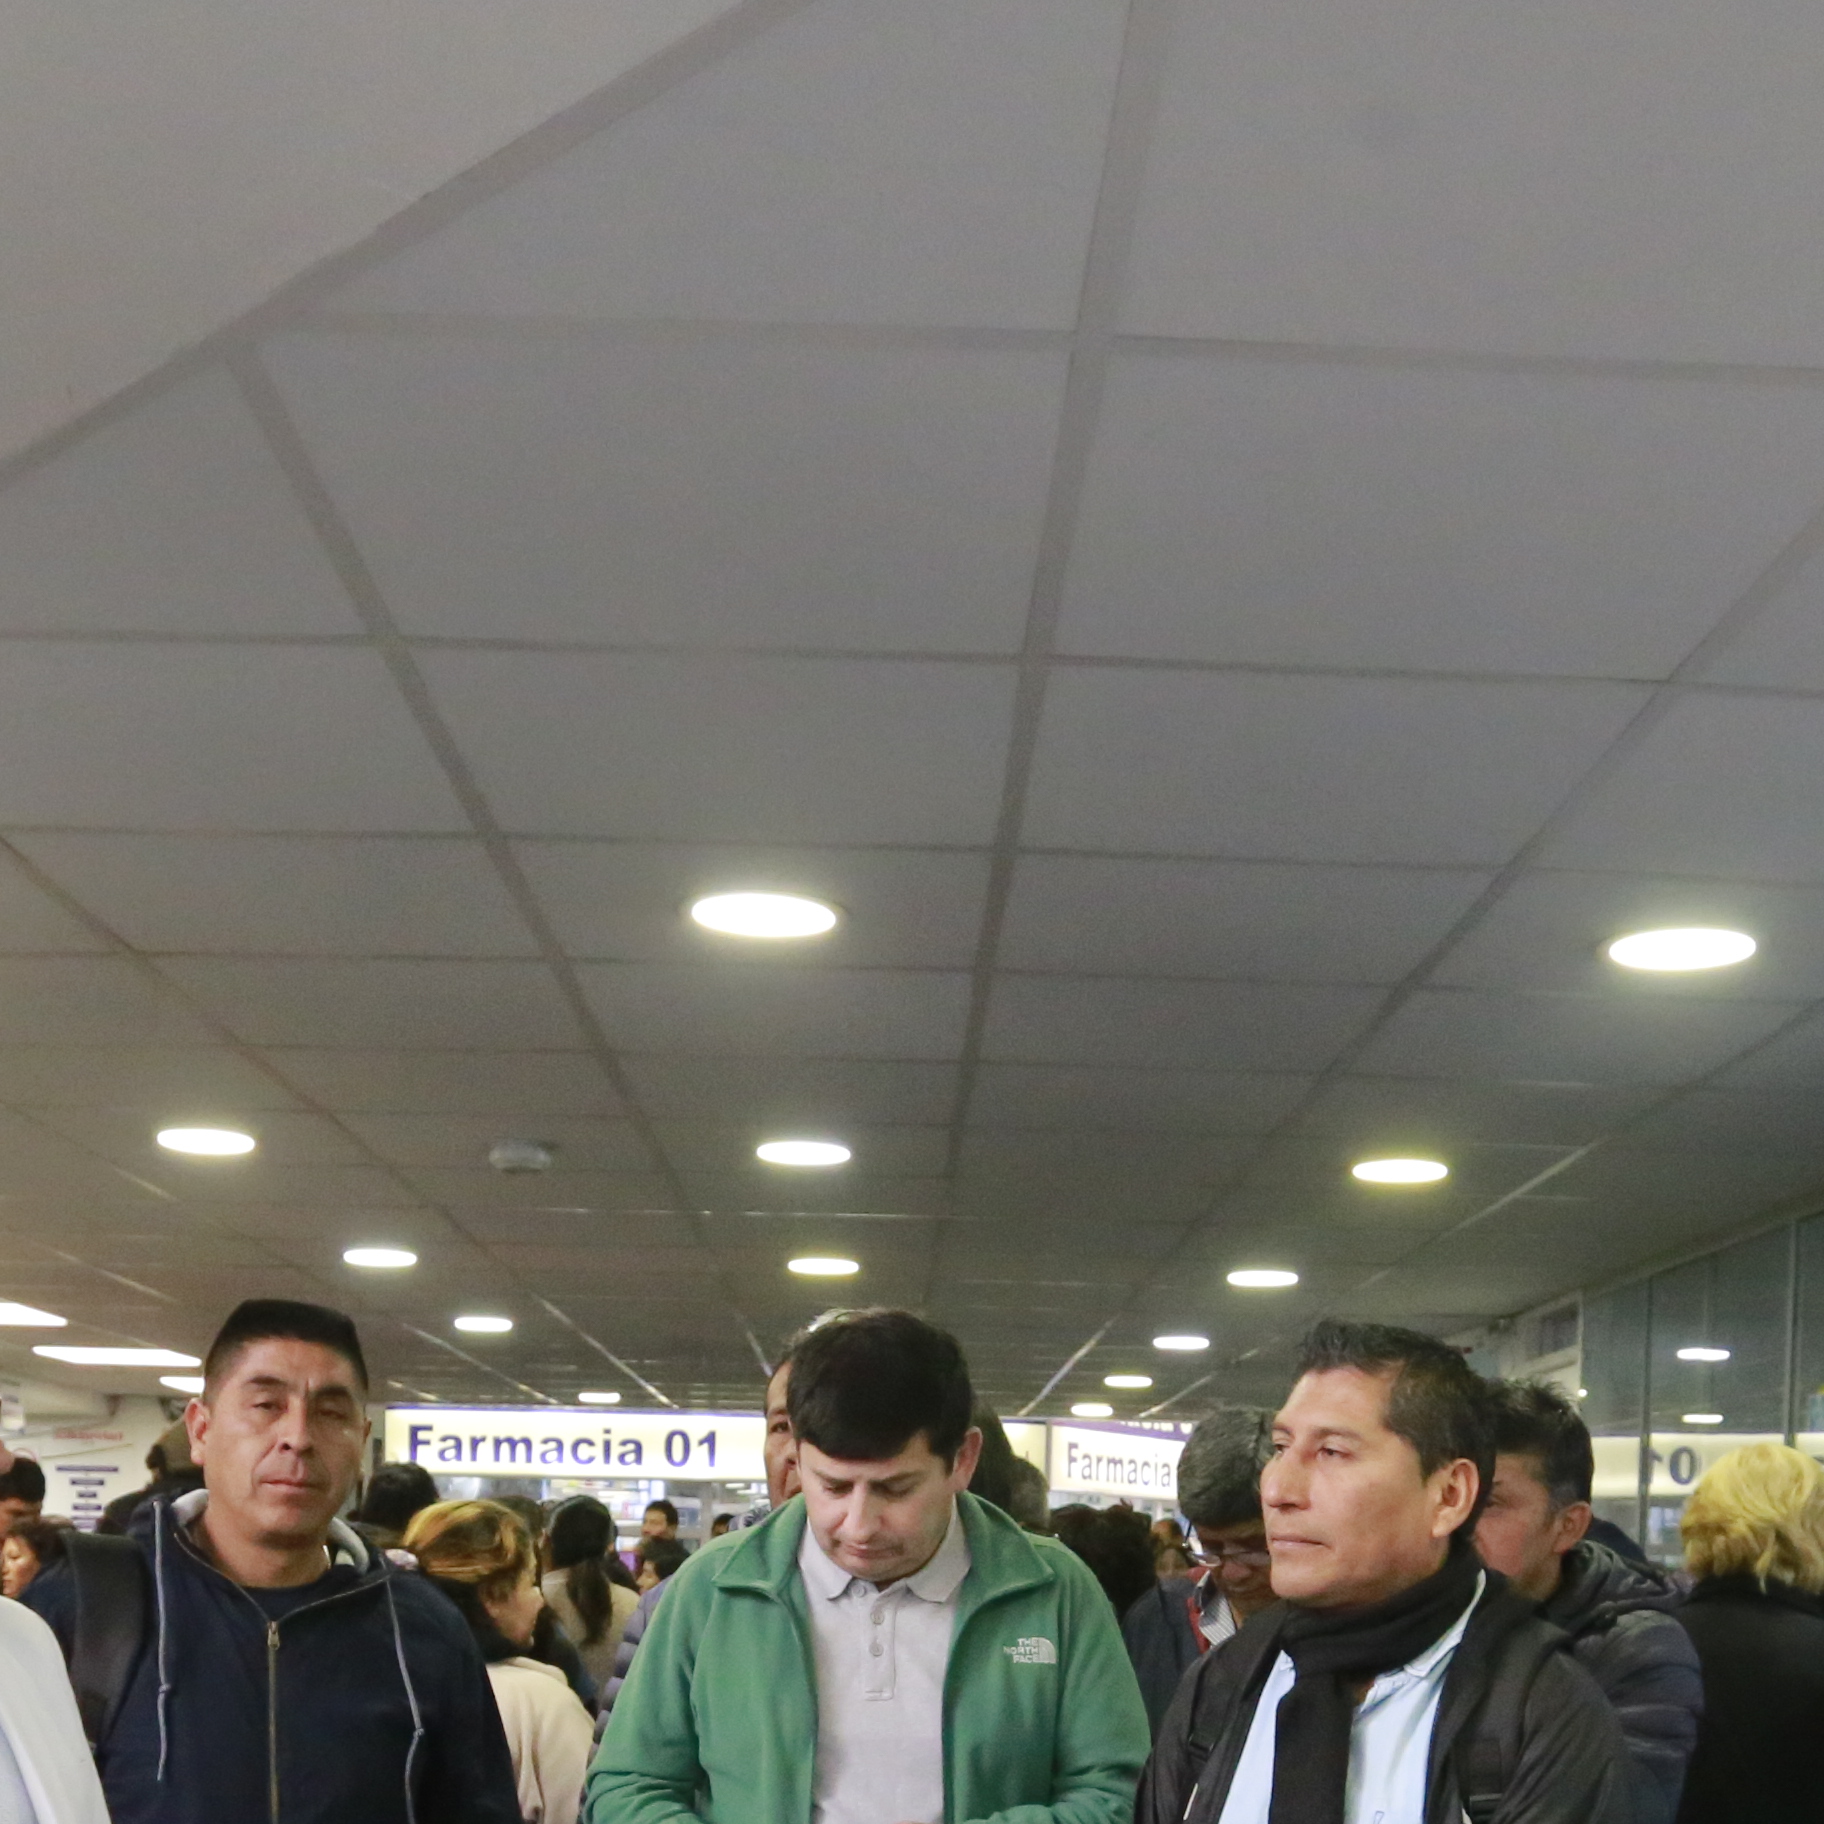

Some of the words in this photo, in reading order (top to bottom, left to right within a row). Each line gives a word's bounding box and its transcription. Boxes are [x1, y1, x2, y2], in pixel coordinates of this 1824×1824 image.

[408, 1424, 644, 1465] Farmacia
[664, 1429, 717, 1467] 01
[1066, 1442, 1171, 1487] Farmacia
[1017, 1637, 1039, 1647] THE
[1003, 1646, 1039, 1655] NORTH
[1013, 1654, 1039, 1664] FACE
